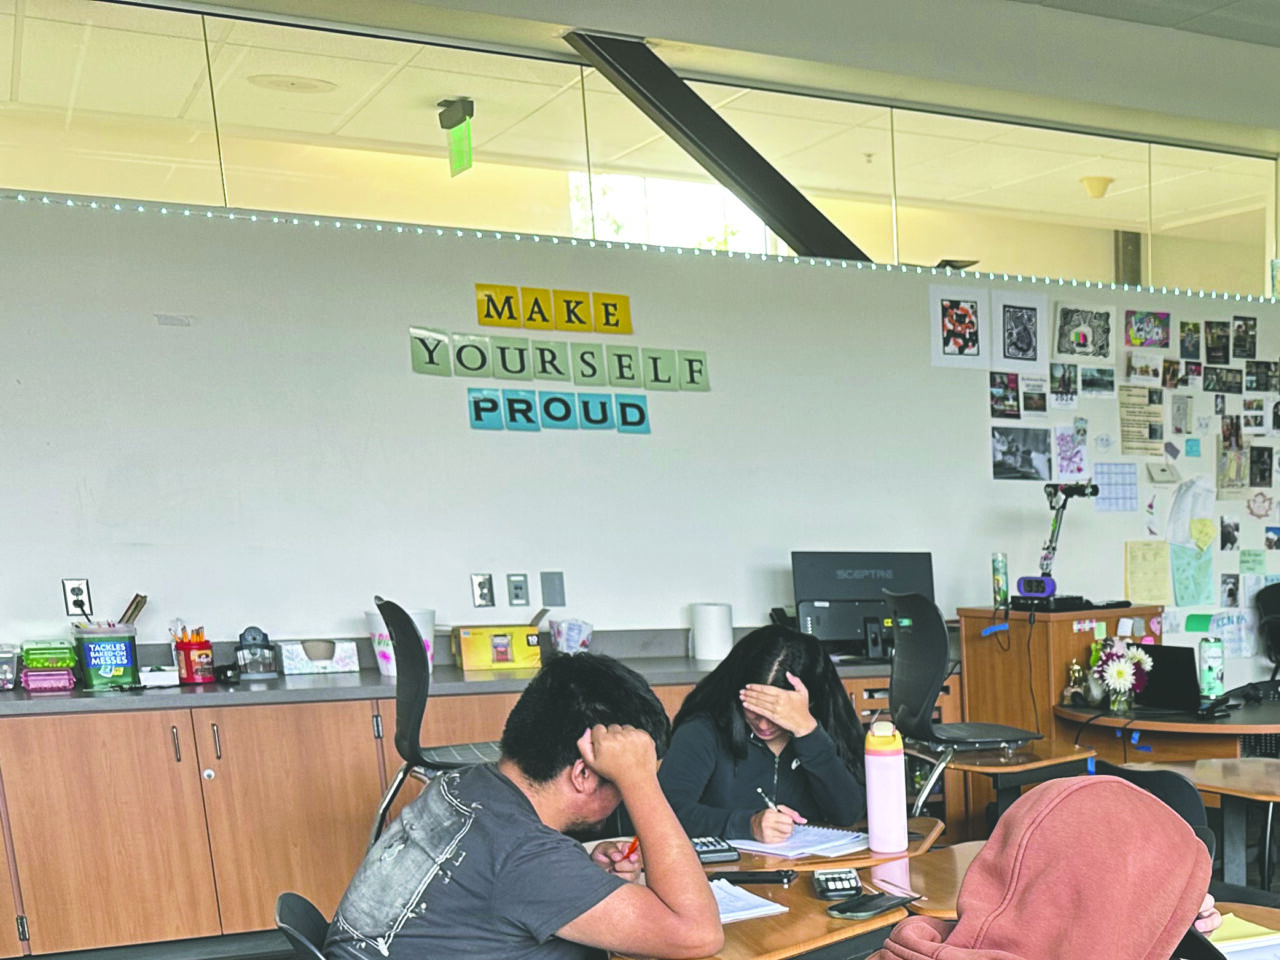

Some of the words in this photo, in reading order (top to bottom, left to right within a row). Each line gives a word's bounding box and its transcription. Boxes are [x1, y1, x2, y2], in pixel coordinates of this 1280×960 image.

[484, 294, 620, 328] MAKE
[414, 336, 704, 385] YOURSELF
[473, 397, 646, 427] PROUD
[836, 570, 893, 580] SCEPTRE
[89, 643, 126, 651] TACKLES
[90, 650, 127, 658] BAKED-ON
[91, 656, 128, 666] MESSES
